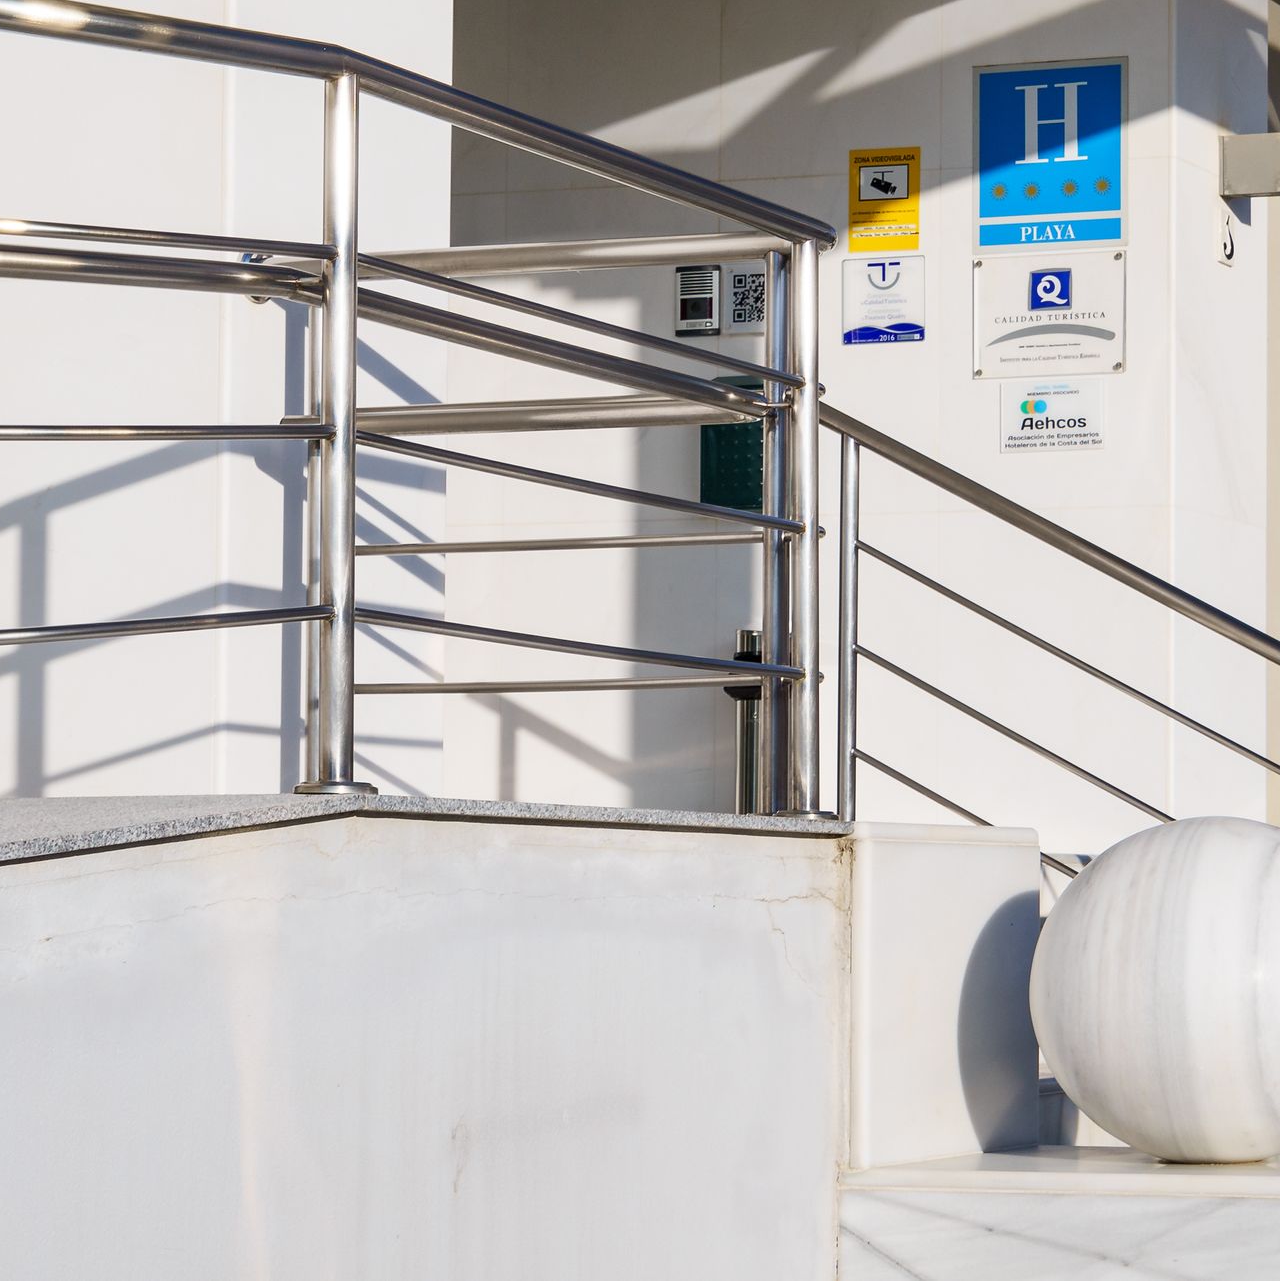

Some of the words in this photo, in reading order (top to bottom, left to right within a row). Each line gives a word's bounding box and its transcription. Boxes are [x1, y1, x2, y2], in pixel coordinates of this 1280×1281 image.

[1014, 81, 1088, 165] H
[853, 156, 870, 164] ZONA
[871, 154, 916, 163] VIDEOVIGILADA
[1020, 224, 1076, 242] PLAYA
[994, 314, 1042, 324] CALIDAD
[1048, 311, 1106, 321] TURÍSTICA
[879, 334, 895, 342] 2016
[1021, 417, 1087, 430] Aehcos
[1007, 433, 1045, 441] Asociación
[1046, 432, 1055, 440] de
[1056, 431, 1099, 440] Empresarios
[1004, 441, 1038, 449] Hoteleros
